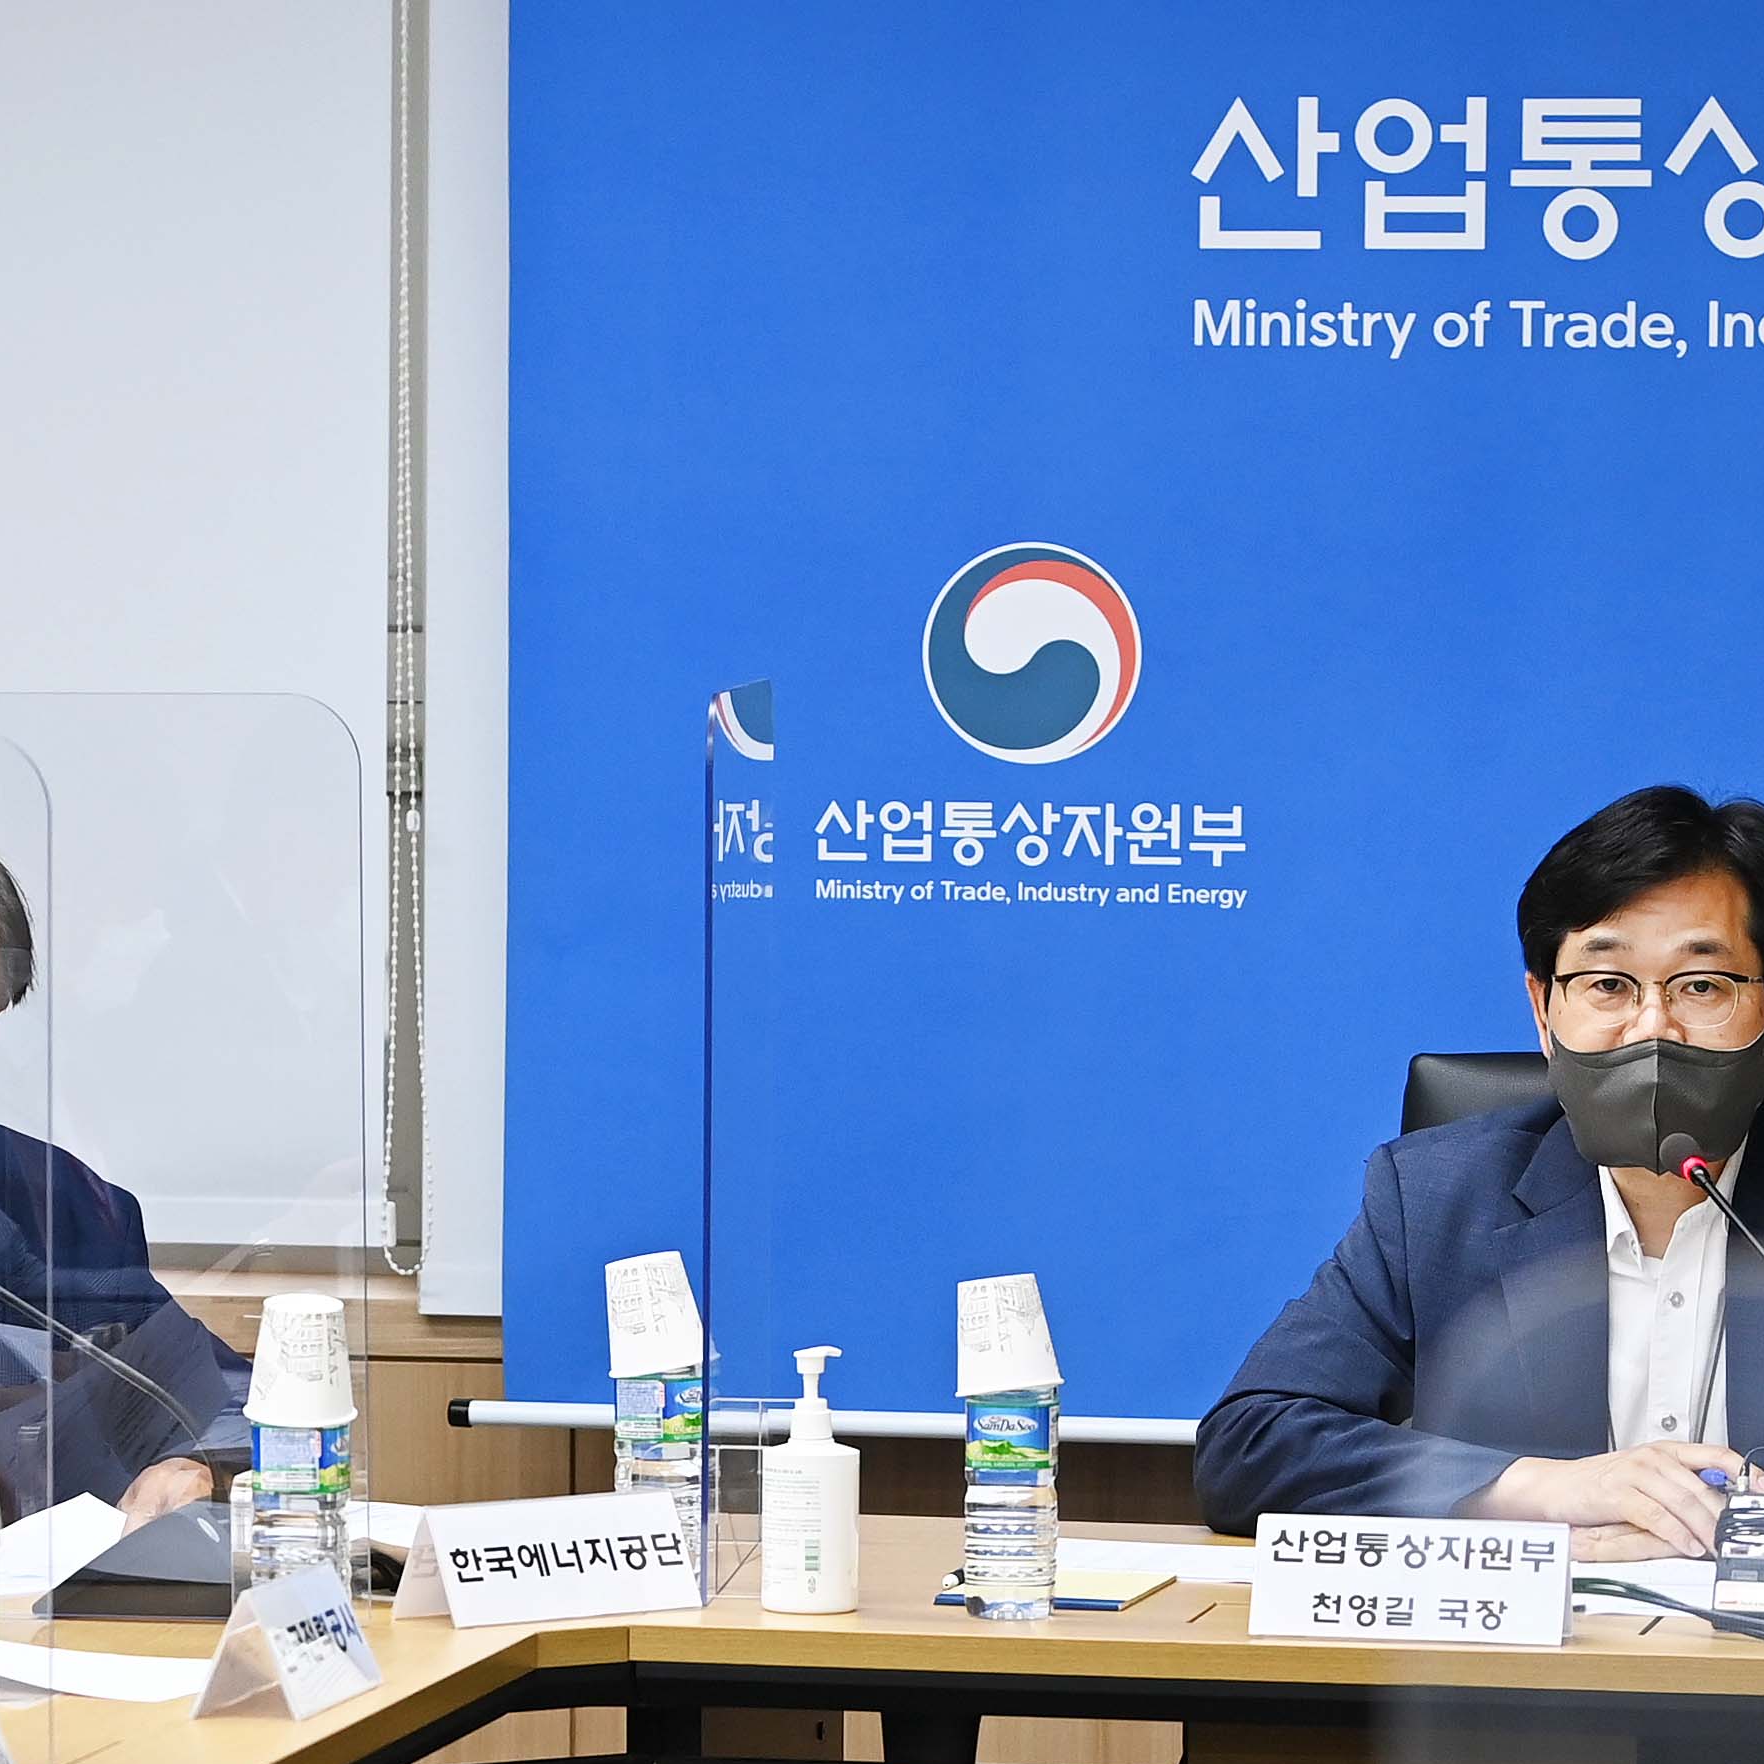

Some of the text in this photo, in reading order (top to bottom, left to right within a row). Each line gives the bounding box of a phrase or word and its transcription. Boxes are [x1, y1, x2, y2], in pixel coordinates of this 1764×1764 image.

[1193, 298, 1417, 360] Ministry
[1433, 300, 1491, 348] of
[1508, 300, 1688, 359] Trade,
[814, 799, 1247, 867] 산업통상자원부
[815, 878, 1248, 909] Ministry of Trade, Industry and Energy
[450, 1532, 684, 1583] 한국에너지공단
[1271, 1529, 1555, 1573] 산업통상자원부
[1311, 1592, 1508, 1631] 천영길 국장
